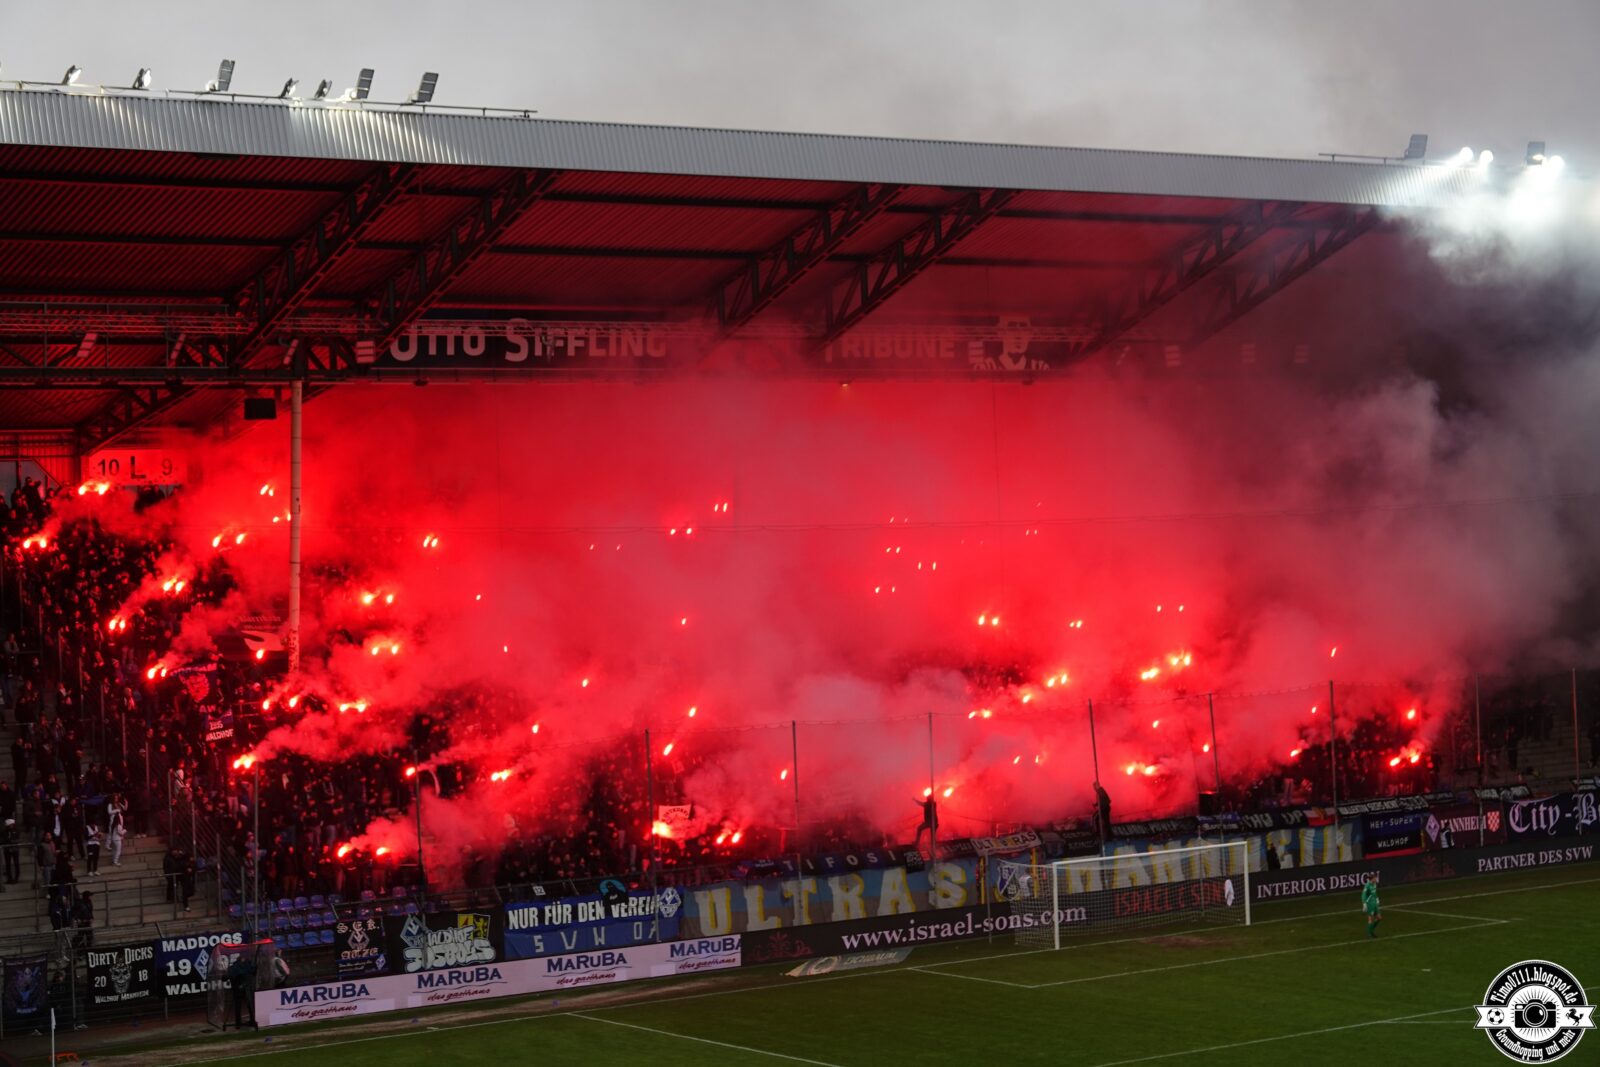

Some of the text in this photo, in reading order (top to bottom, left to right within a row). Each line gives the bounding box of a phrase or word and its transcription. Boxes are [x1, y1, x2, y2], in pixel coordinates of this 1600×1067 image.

[98, 455, 173, 479] 10 L 9
[1376, 836, 1409, 849] WALDHOF
[1478, 845, 1593, 872] PARTNER DES SVW
[695, 861, 967, 937] ULTRAS
[1257, 876, 1326, 899] INTERIOR
[508, 906, 539, 930] NUR
[544, 901, 573, 926] FÜR
[577, 899, 606, 923] DEN
[841, 904, 1087, 951] www.israel-sons.com
[162, 932, 243, 953] MADDOGS
[87, 945, 153, 968] DIRTY DICKS
[165, 958, 192, 977] 19
[94, 969, 148, 988] 20 18
